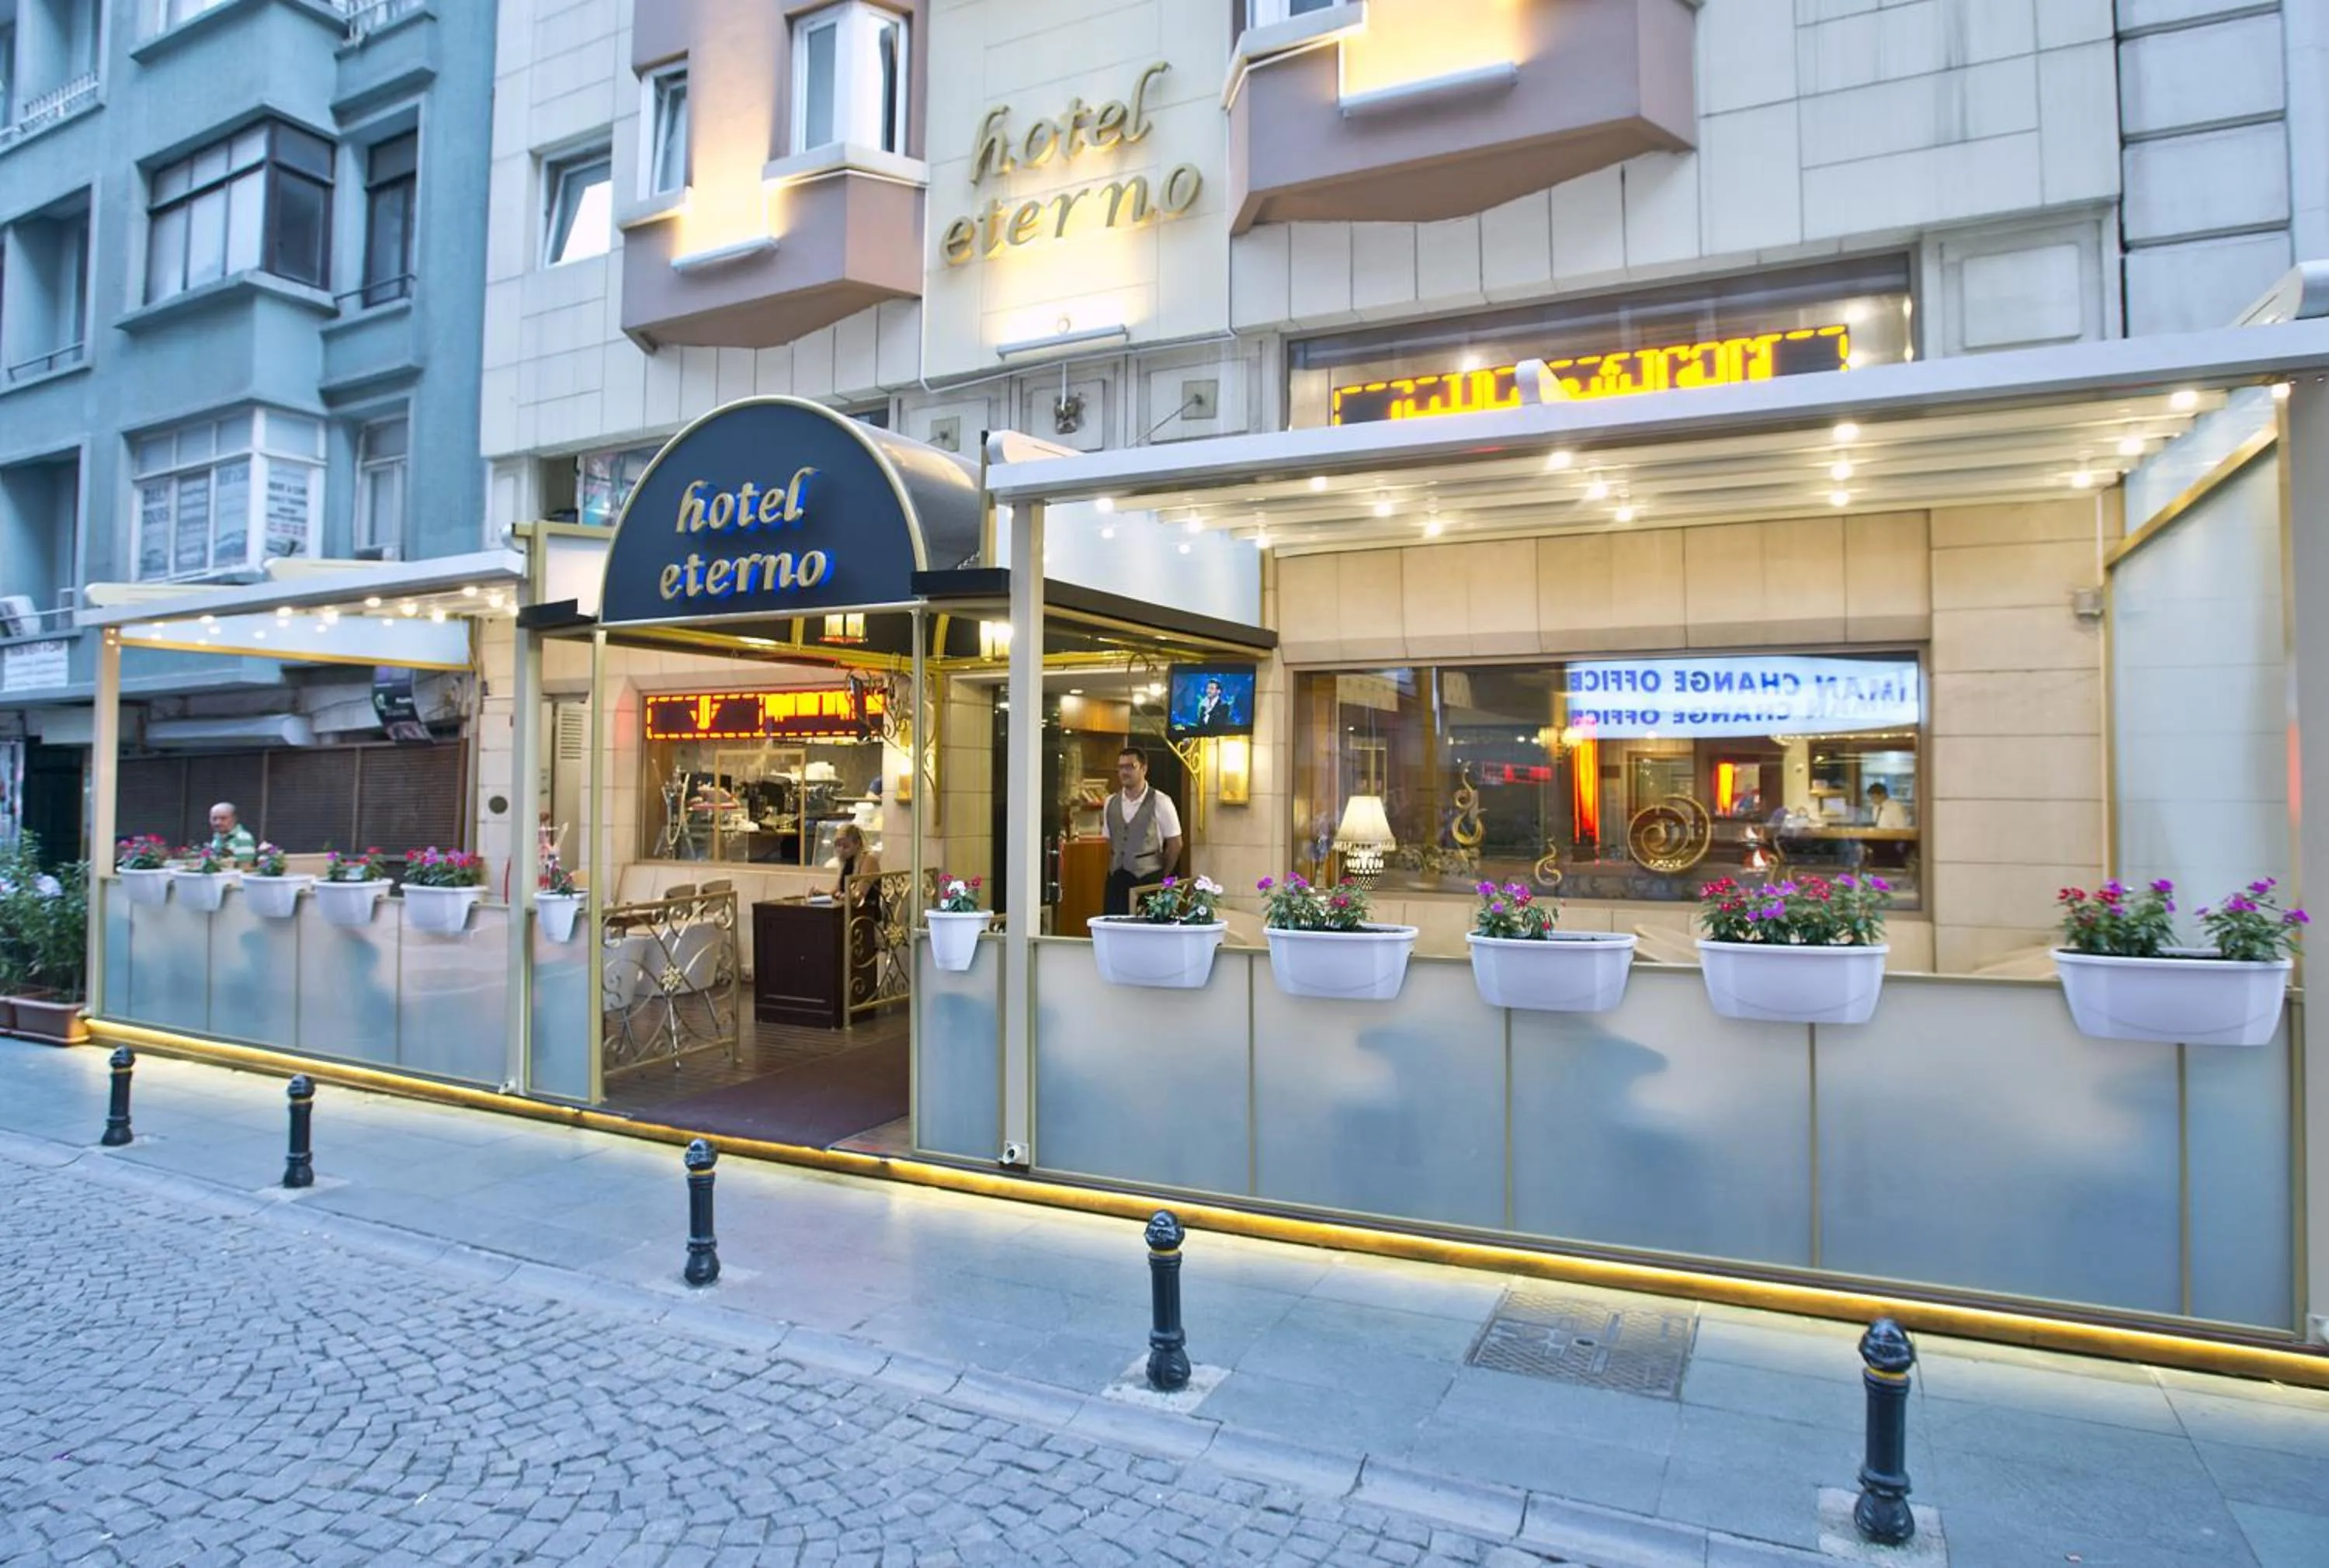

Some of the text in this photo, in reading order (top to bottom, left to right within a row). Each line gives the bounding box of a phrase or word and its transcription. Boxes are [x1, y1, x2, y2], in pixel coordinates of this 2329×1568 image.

[969, 61, 1171, 186] hotel
[940, 162, 1203, 265] eterno
[675, 467, 820, 533] hotel
[660, 550, 827, 600] eterno
